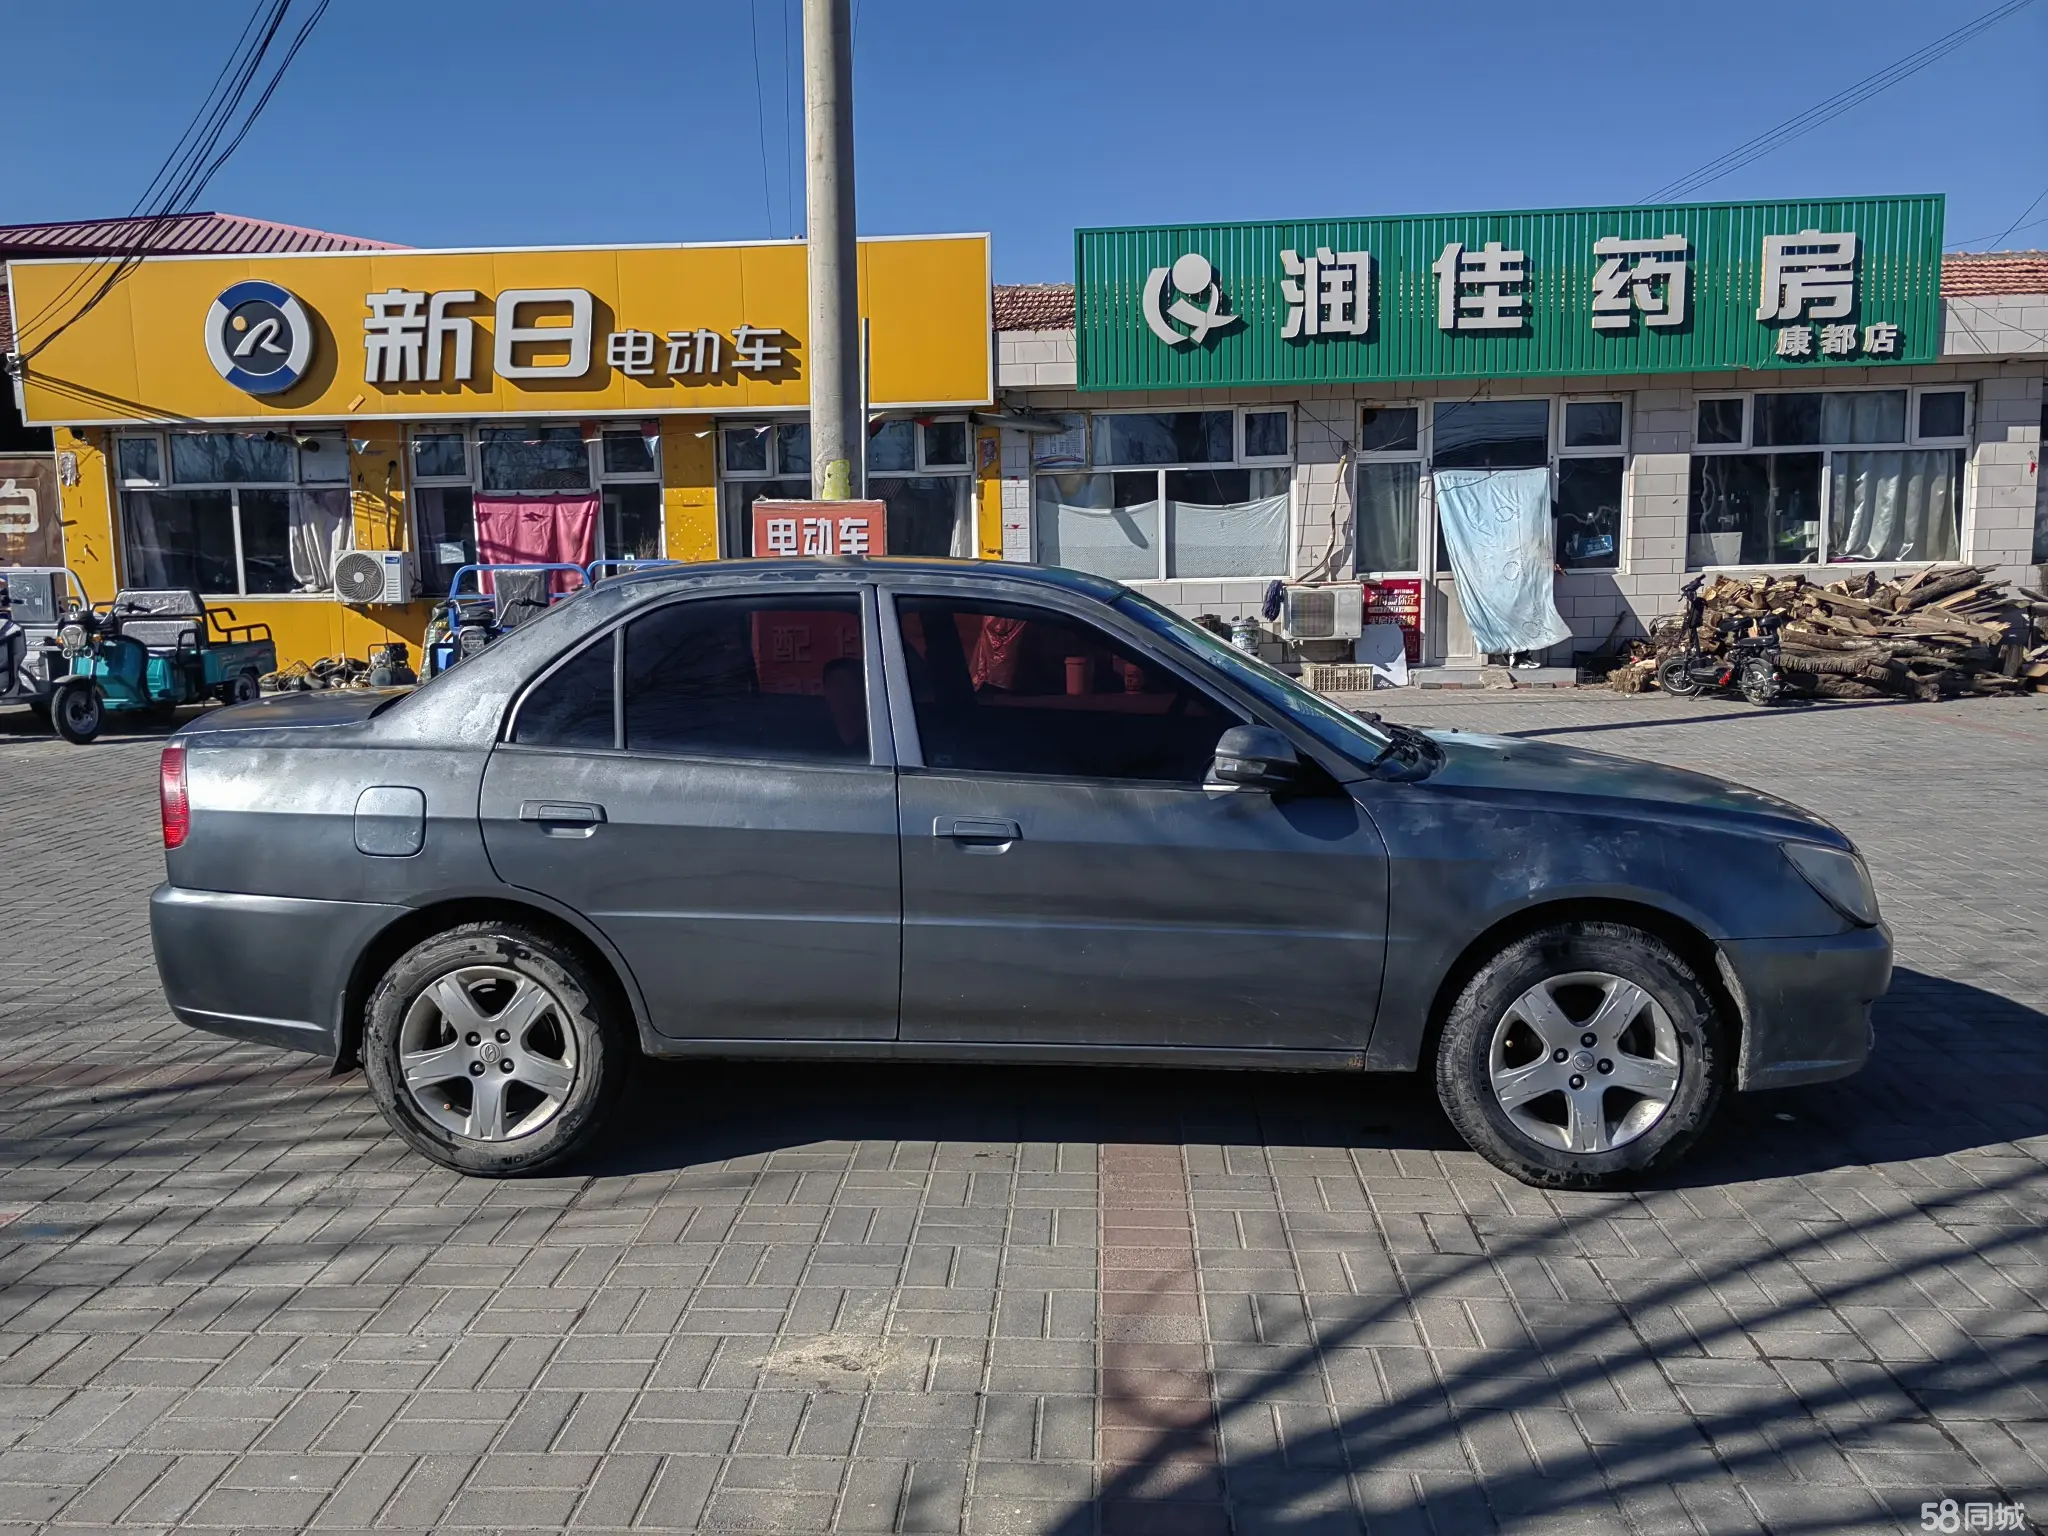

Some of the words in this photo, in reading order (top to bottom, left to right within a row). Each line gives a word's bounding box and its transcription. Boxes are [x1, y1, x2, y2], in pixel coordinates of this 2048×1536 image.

[1280, 229, 1857, 339] 润佳药房
[363, 288, 593, 383] 新日
[606, 325, 782, 375] 电动车
[1776, 321, 1898, 358] 康都店
[766, 516, 869, 556] 电动车
